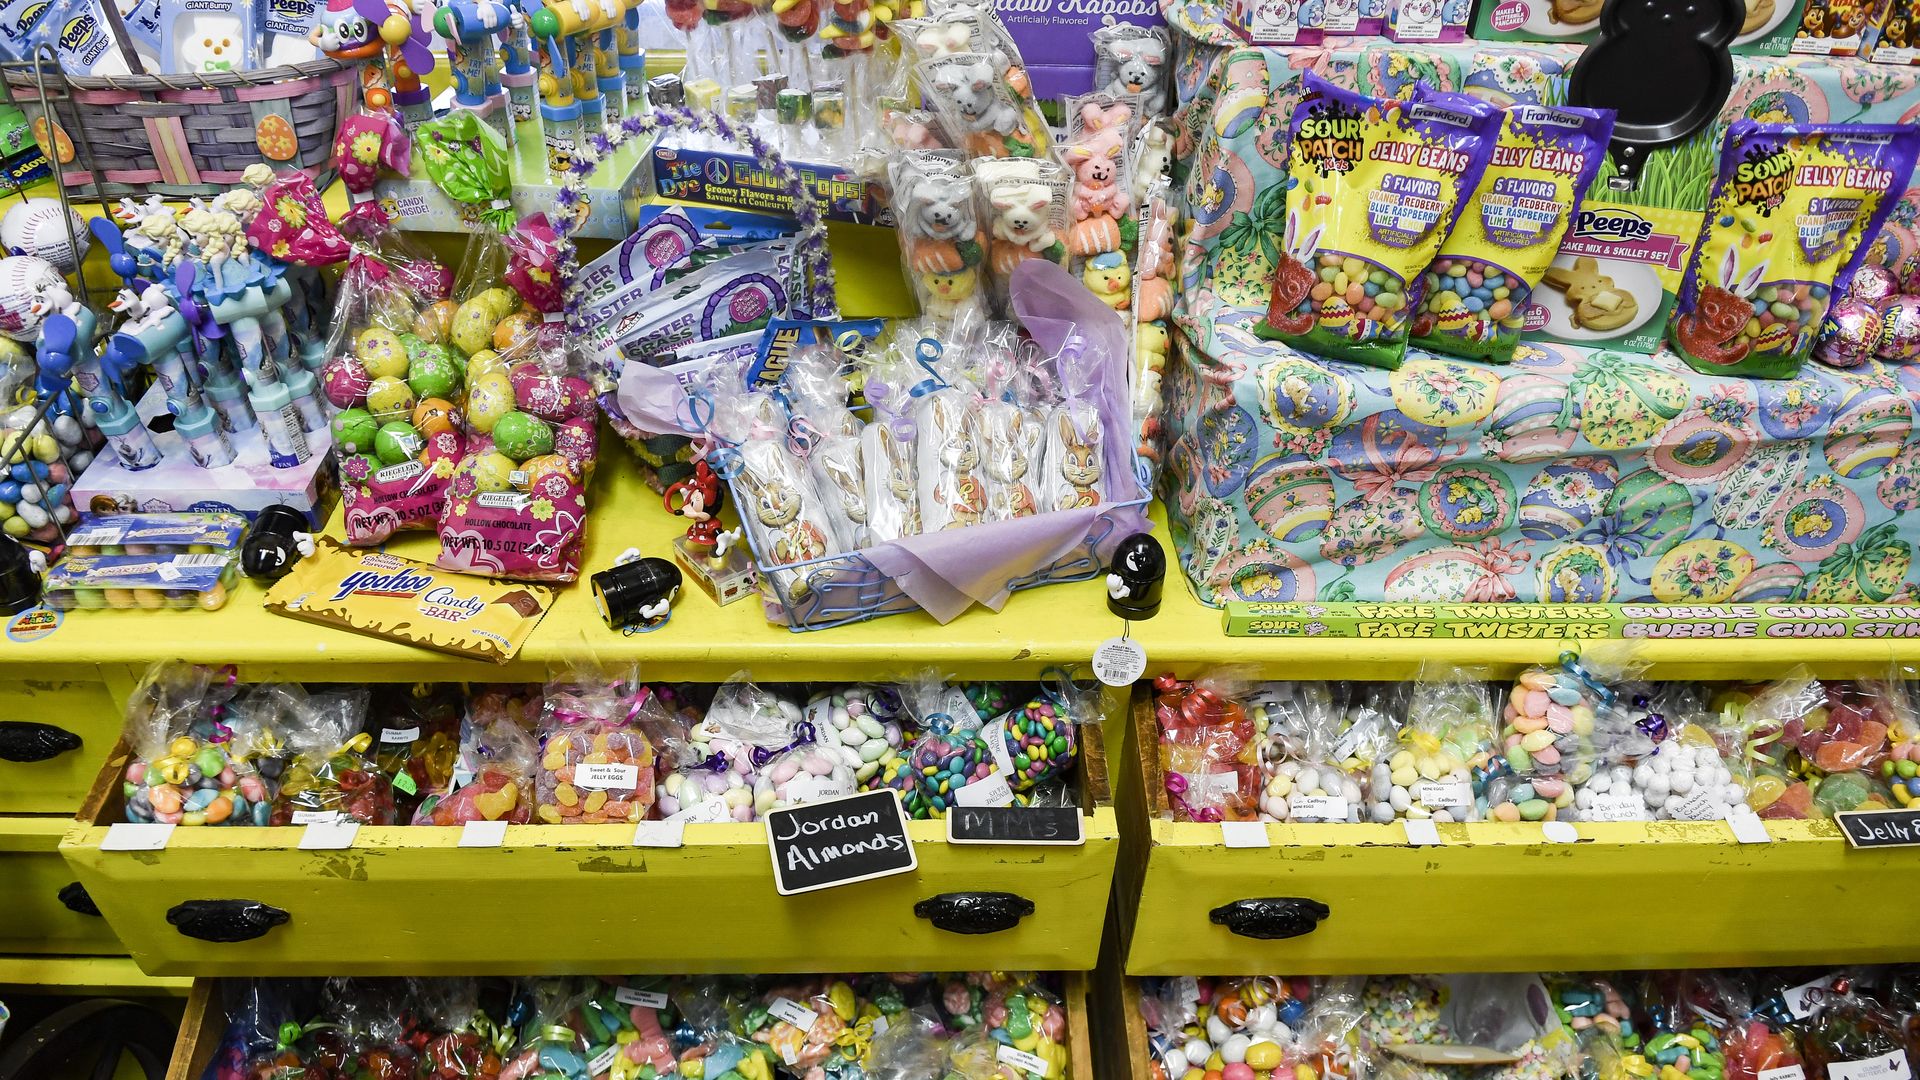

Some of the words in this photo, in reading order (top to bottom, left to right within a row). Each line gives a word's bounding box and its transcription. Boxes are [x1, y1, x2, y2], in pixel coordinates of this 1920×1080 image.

[186, 2, 209, 11] GIANT
[210, 1, 232, 11] Bunny
[1495, 8, 1514, 16] MAKES
[1515, 3, 1521, 12] 6
[265, 20, 288, 30] GIANT
[288, 22, 309, 34] Bunny
[1007, 15, 1049, 25] Artificially
[1052, 16, 1089, 25] Flavored
[1495, 18, 1523, 28] PANCAKES
[59, 14, 96, 52] Peeps
[83, 47, 101, 66] GIANT
[1301, 119, 1360, 139] SOUR
[1300, 138, 1363, 162] PATCH
[1370, 142, 1416, 165] JELLY
[1418, 147, 1469, 173] BEANS
[1323, 158, 1349, 171] Kids
[1491, 147, 1529, 168] ELLY
[1532, 149, 1584, 173] BEANS
[1737, 153, 1793, 182] SOUR
[666, 160, 701, 180] Tie
[1795, 166, 1842, 187] JELLY
[1846, 168, 1893, 189] BEANS
[658, 178, 701, 197] Dye
[733, 161, 783, 190] Cub
[800, 170, 868, 203] Pops!
[1382, 176, 1390, 189] 5
[1394, 177, 1440, 196] FLAVORS
[1496, 180, 1503, 192] 5
[1507, 180, 1555, 198] FLAVORS
[1735, 170, 1793, 203] PATCH
[705, 184, 739, 196] Groovy
[740, 187, 775, 200] Flavors
[706, 192, 738, 202] Saveurs
[748, 197, 785, 209] Couleurs
[397, 196, 424, 208] CANDY
[1369, 191, 1398, 204] ORANGE
[1404, 197, 1445, 212] REDBERRY
[1481, 194, 1513, 206] ORANGE
[1518, 198, 1562, 213] REDBERRY
[1810, 199, 1818, 211] 5
[400, 205, 429, 217] INSIDE!
[1370, 202, 1389, 214] BLUE
[1392, 206, 1438, 222] RASPBERRY
[1483, 205, 1503, 216] BLUE
[1506, 207, 1555, 223] RASPBERRY
[1375, 214, 1392, 226] LIME
[1399, 218, 1425, 231] LEMON
[1489, 216, 1507, 227] LIME
[1513, 219, 1540, 231] LEMON
[1575, 211, 1653, 238] Peeps
[1378, 229, 1419, 240] ARTIFICIALLY
[1493, 230, 1535, 240] ARTIFICIALLY
[1800, 226, 1821, 238] BLUE
[1381, 235, 1414, 247] FLAVORED
[1496, 236, 1531, 246] FLAVORED
[1585, 244, 1601, 253] MIX
[1603, 245, 1610, 254] &
[1613, 247, 1648, 258] SKILLET
[1650, 251, 1668, 261] SET
[582, 264, 616, 291] TER
[591, 287, 643, 325] ASTER
[1535, 308, 1543, 316] 6
[624, 313, 696, 351] EASTER
[1883, 305, 1902, 345] WONDER
[629, 327, 693, 358] GRASS
[755, 327, 800, 386] EAGUE
[379, 463, 419, 476] RIEGELEIN
[374, 492, 401, 505] HOLLOW
[355, 516, 373, 528] NET
[395, 508, 416, 521] 10.5
[418, 506, 431, 518] OZ
[464, 518, 491, 528] HOLLOW
[493, 520, 532, 531] CHOCOLATE
[443, 537, 460, 548] NET
[483, 541, 502, 551] 10.5
[504, 542, 517, 554] OZ
[361, 560, 398, 571] Flavored
[364, 556, 404, 567] Chocolate
[424, 587, 485, 616] Candy
[18, 615, 55, 625] MARIO
[1355, 605, 1436, 619] FACE
[1442, 605, 1614, 619] TWISTERS
[1620, 606, 1760, 619] BUBBLE
[1764, 606, 1848, 618] GUM
[1249, 620, 1300, 630] SOUR
[1357, 621, 1436, 638] FACE
[1443, 622, 1611, 638] TWISTERS
[1622, 622, 1760, 638] BUBBLE
[1765, 622, 1847, 638] GUM
[817, 721, 830, 744] JORDAN
[817, 789, 840, 797] JORDAN
[776, 811, 880, 843] Jordan
[1858, 818, 1909, 843] Jelly
[787, 832, 906, 872] Almonds
